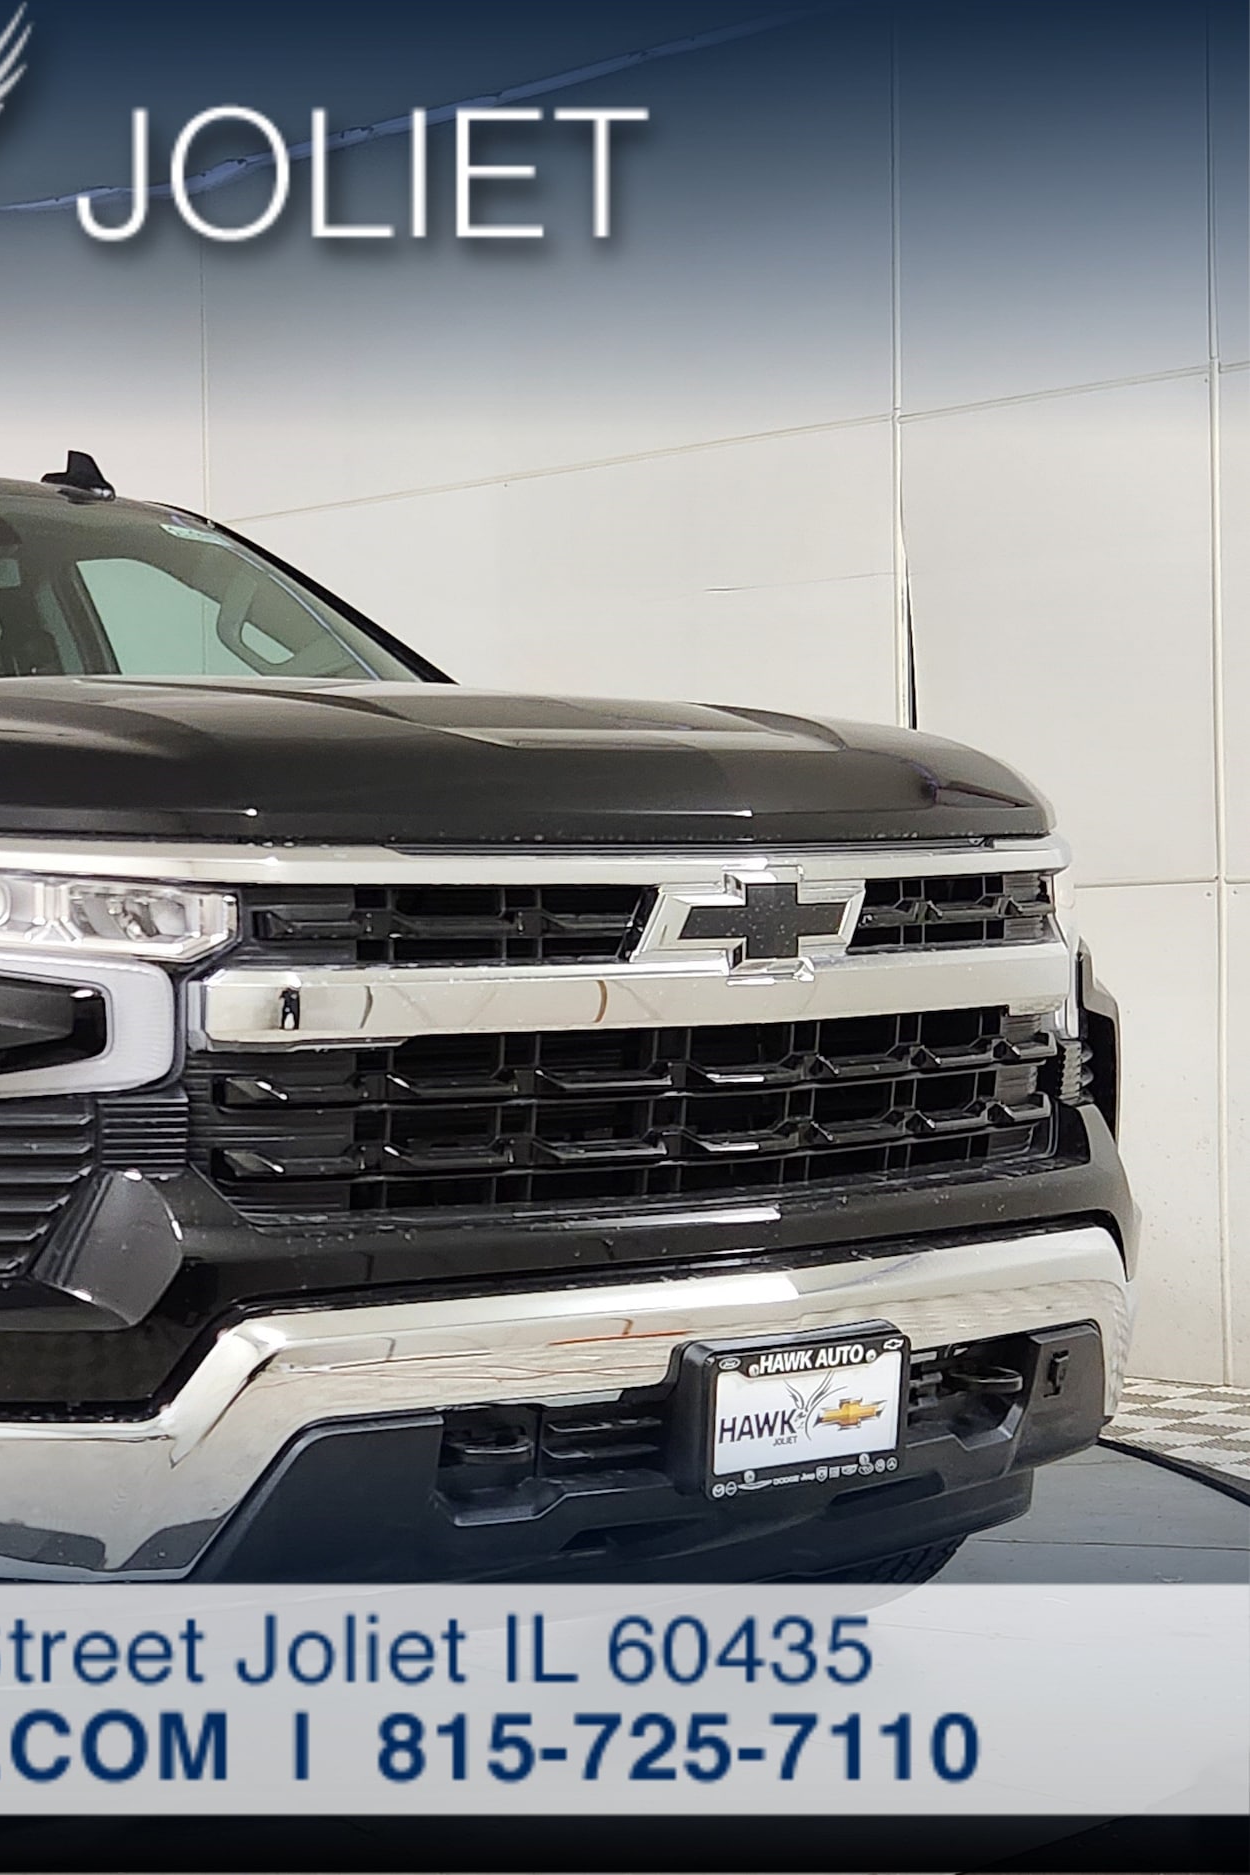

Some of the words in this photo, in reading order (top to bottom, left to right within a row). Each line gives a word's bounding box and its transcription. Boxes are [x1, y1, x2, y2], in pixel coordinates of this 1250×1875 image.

[759, 1350, 812, 1374] HAWK
[815, 1344, 864, 1367] AUTO
[718, 1408, 797, 1444] HAWK
[772, 1436, 798, 1447] JOLIET
